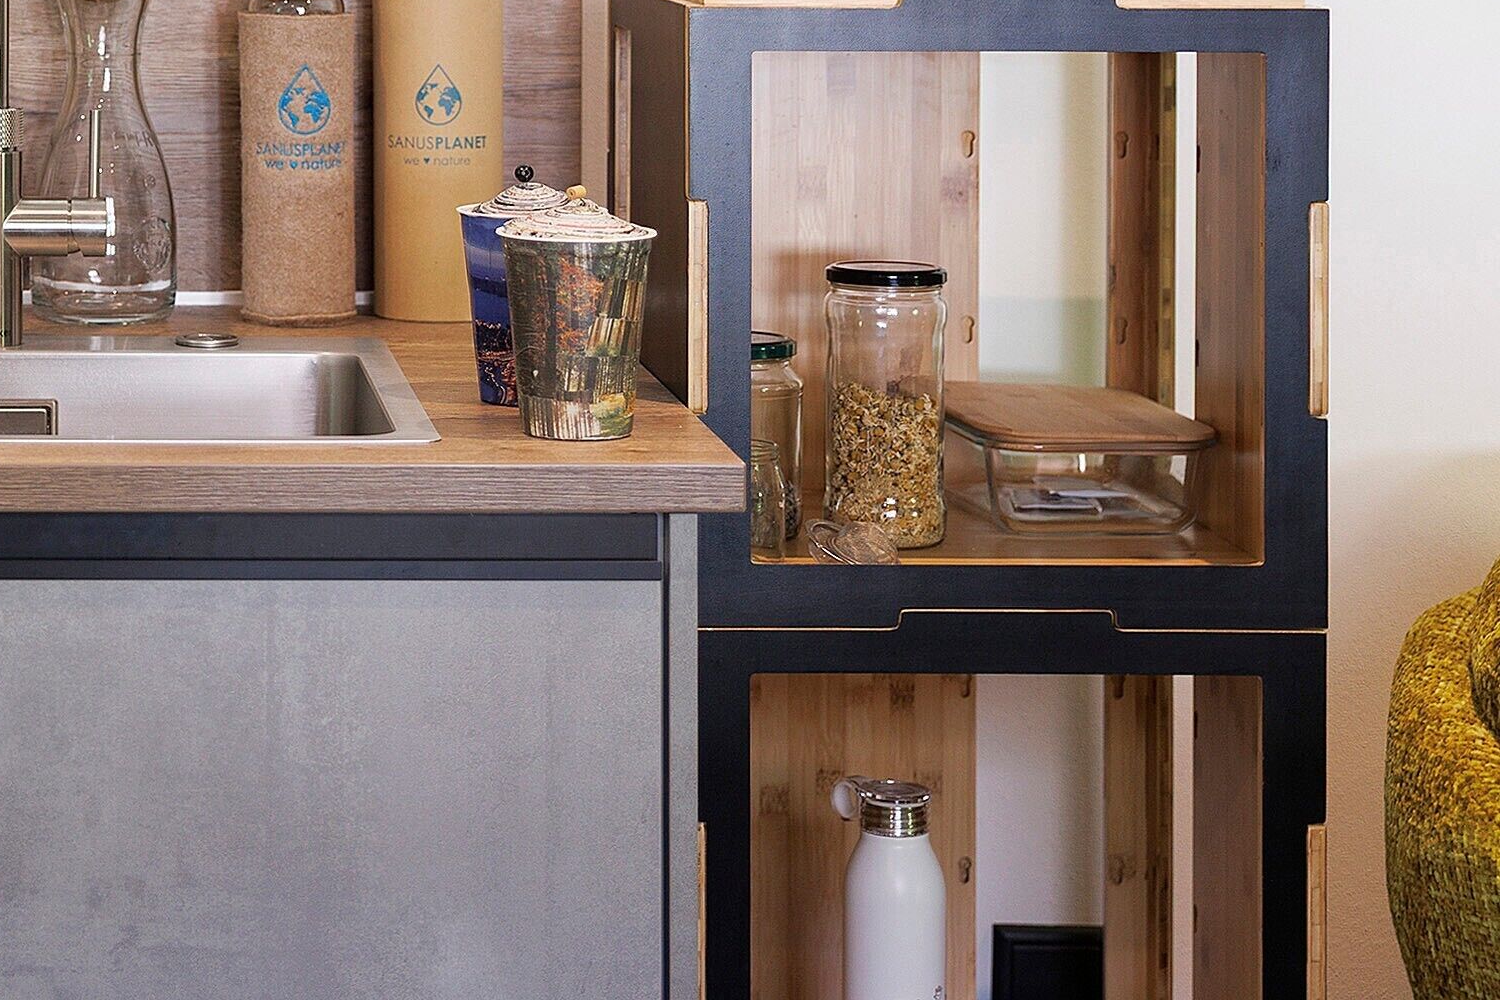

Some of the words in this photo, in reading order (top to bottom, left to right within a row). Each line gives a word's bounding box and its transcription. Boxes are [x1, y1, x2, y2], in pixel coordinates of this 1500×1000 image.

[388, 134, 486, 149] SANUSPLANET
[265, 159, 284, 169] we
[403, 156, 420, 166] we
[433, 155, 471, 167] nature
